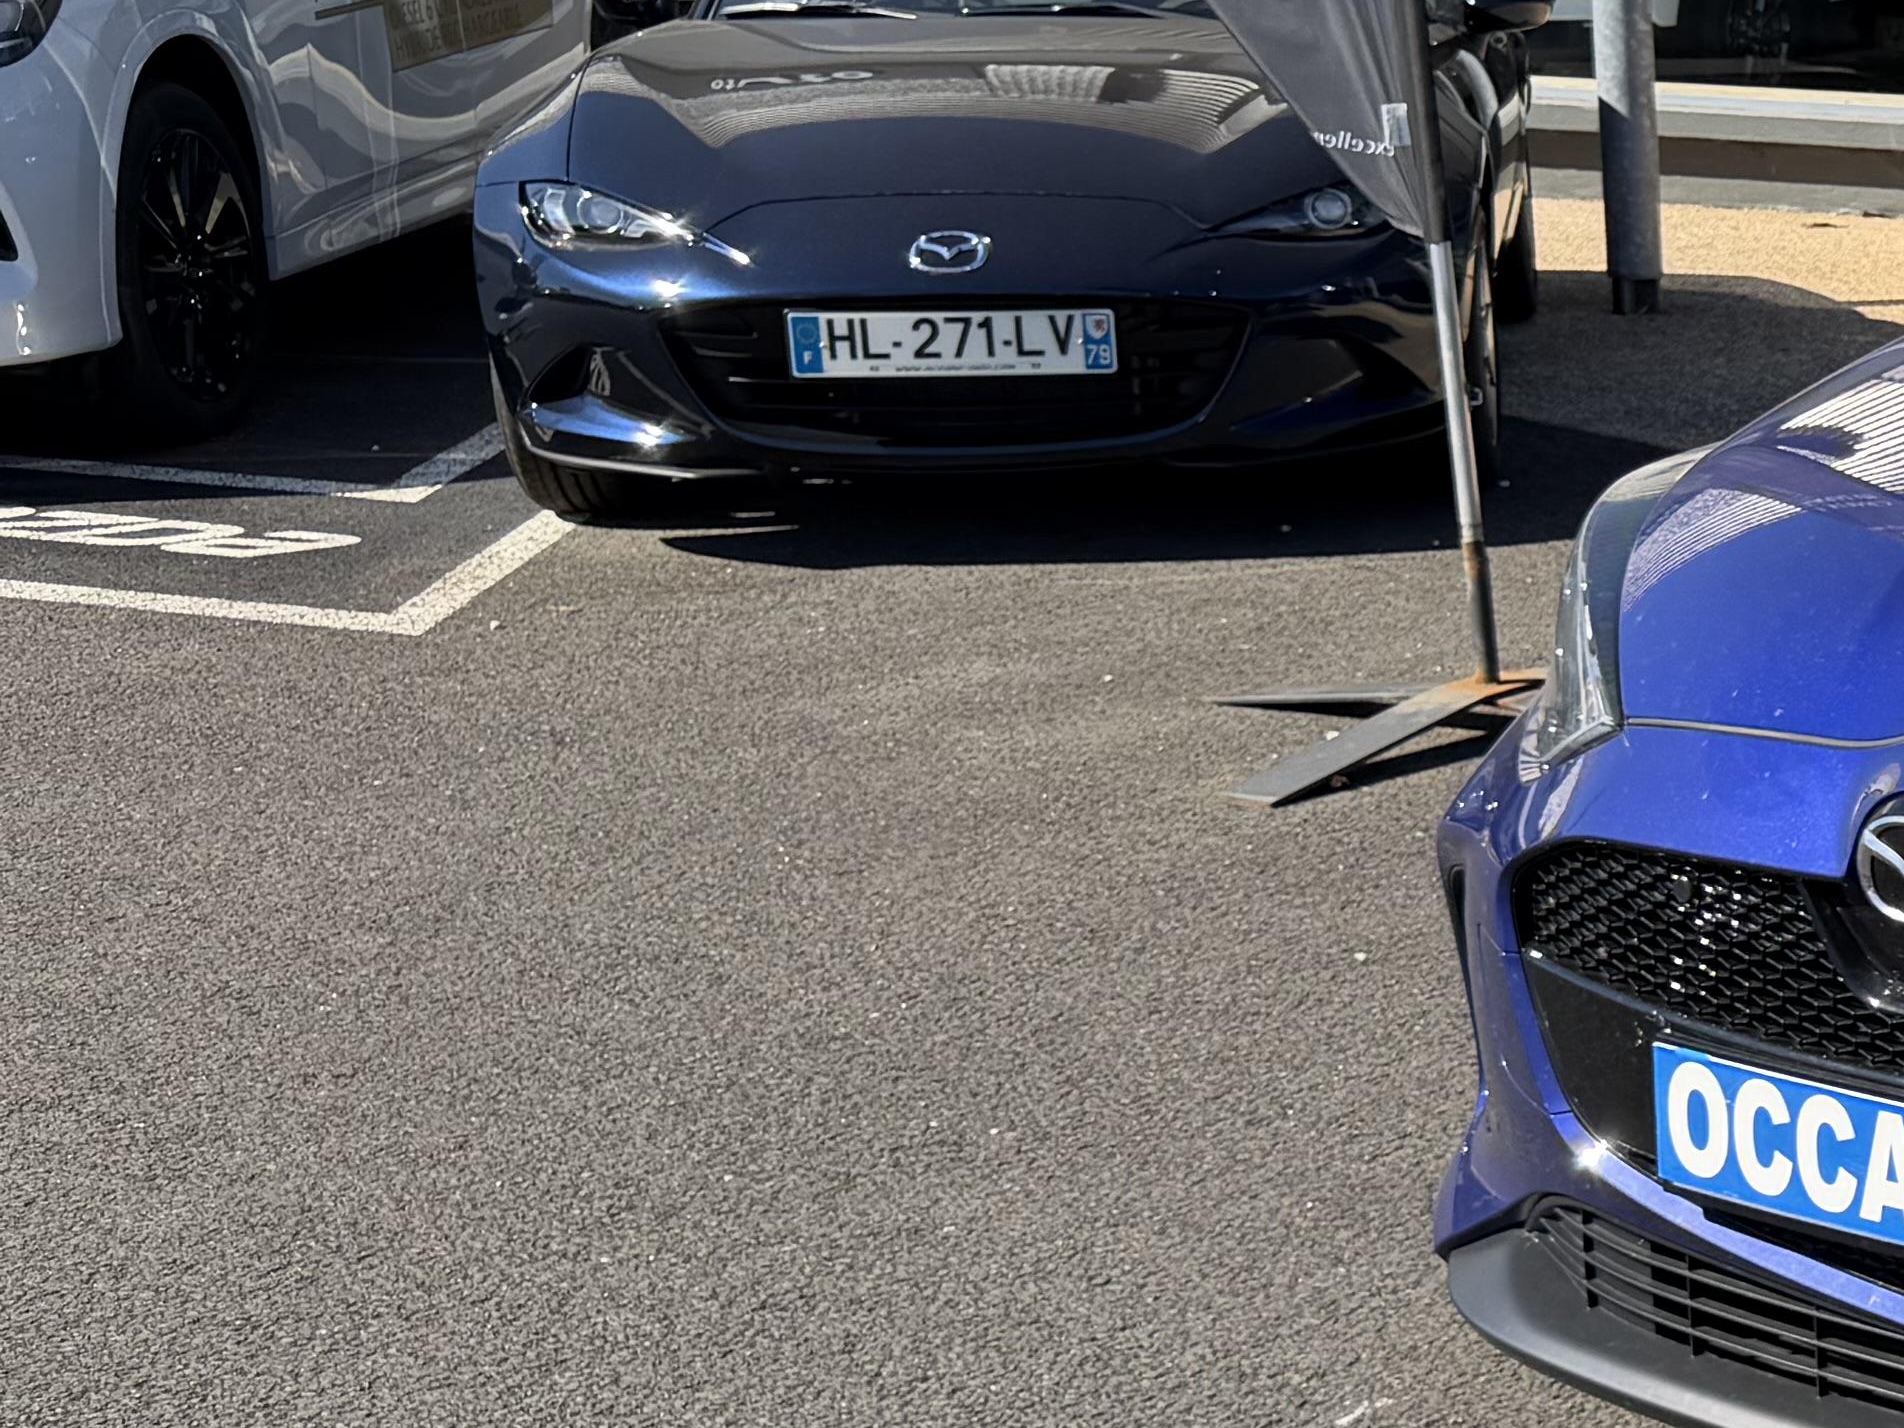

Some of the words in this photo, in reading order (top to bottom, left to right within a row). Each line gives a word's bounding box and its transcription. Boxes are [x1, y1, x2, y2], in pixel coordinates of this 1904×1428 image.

[802, 351, 813, 365] F
[826, 314, 1076, 361] HL-271-LV
[1085, 343, 1112, 366] 79
